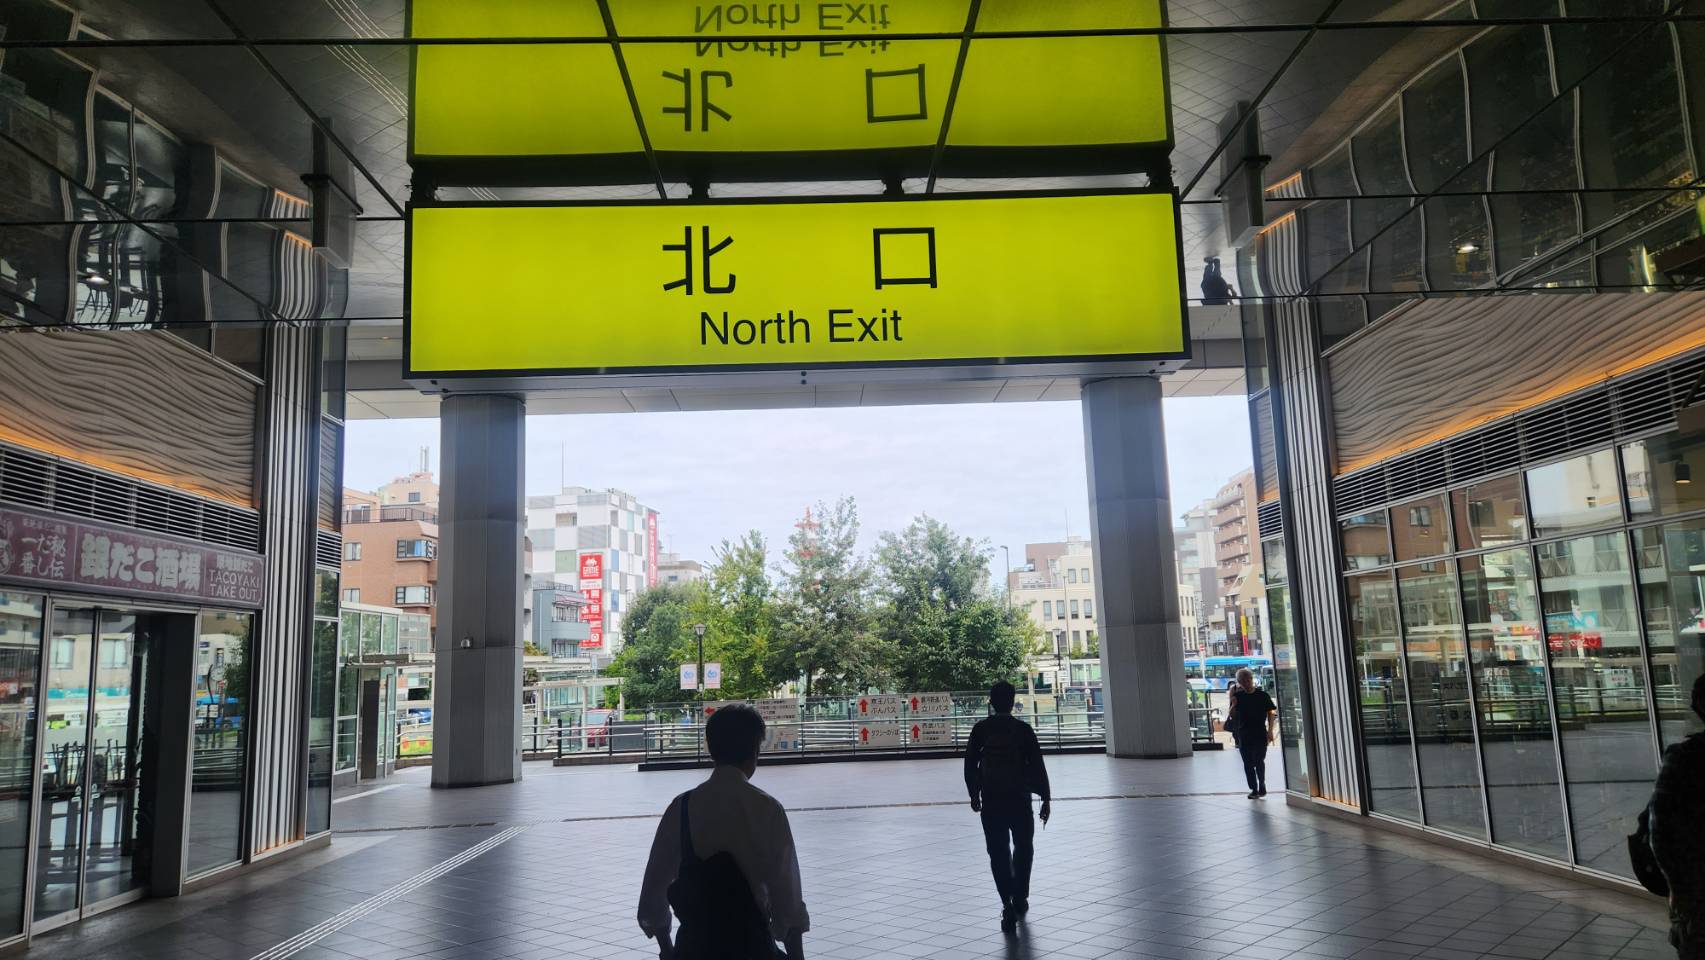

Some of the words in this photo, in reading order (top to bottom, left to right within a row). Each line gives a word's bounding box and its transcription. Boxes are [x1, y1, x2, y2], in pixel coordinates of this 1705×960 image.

[700, 310, 811, 345] North
[828, 308, 903, 343] Exit
[80, 531, 202, 592] 銀だこ酒場
[208, 568, 260, 589] TACOYAKI
[210, 583, 237, 599] TAKE
[239, 587, 258, 601] OUT
